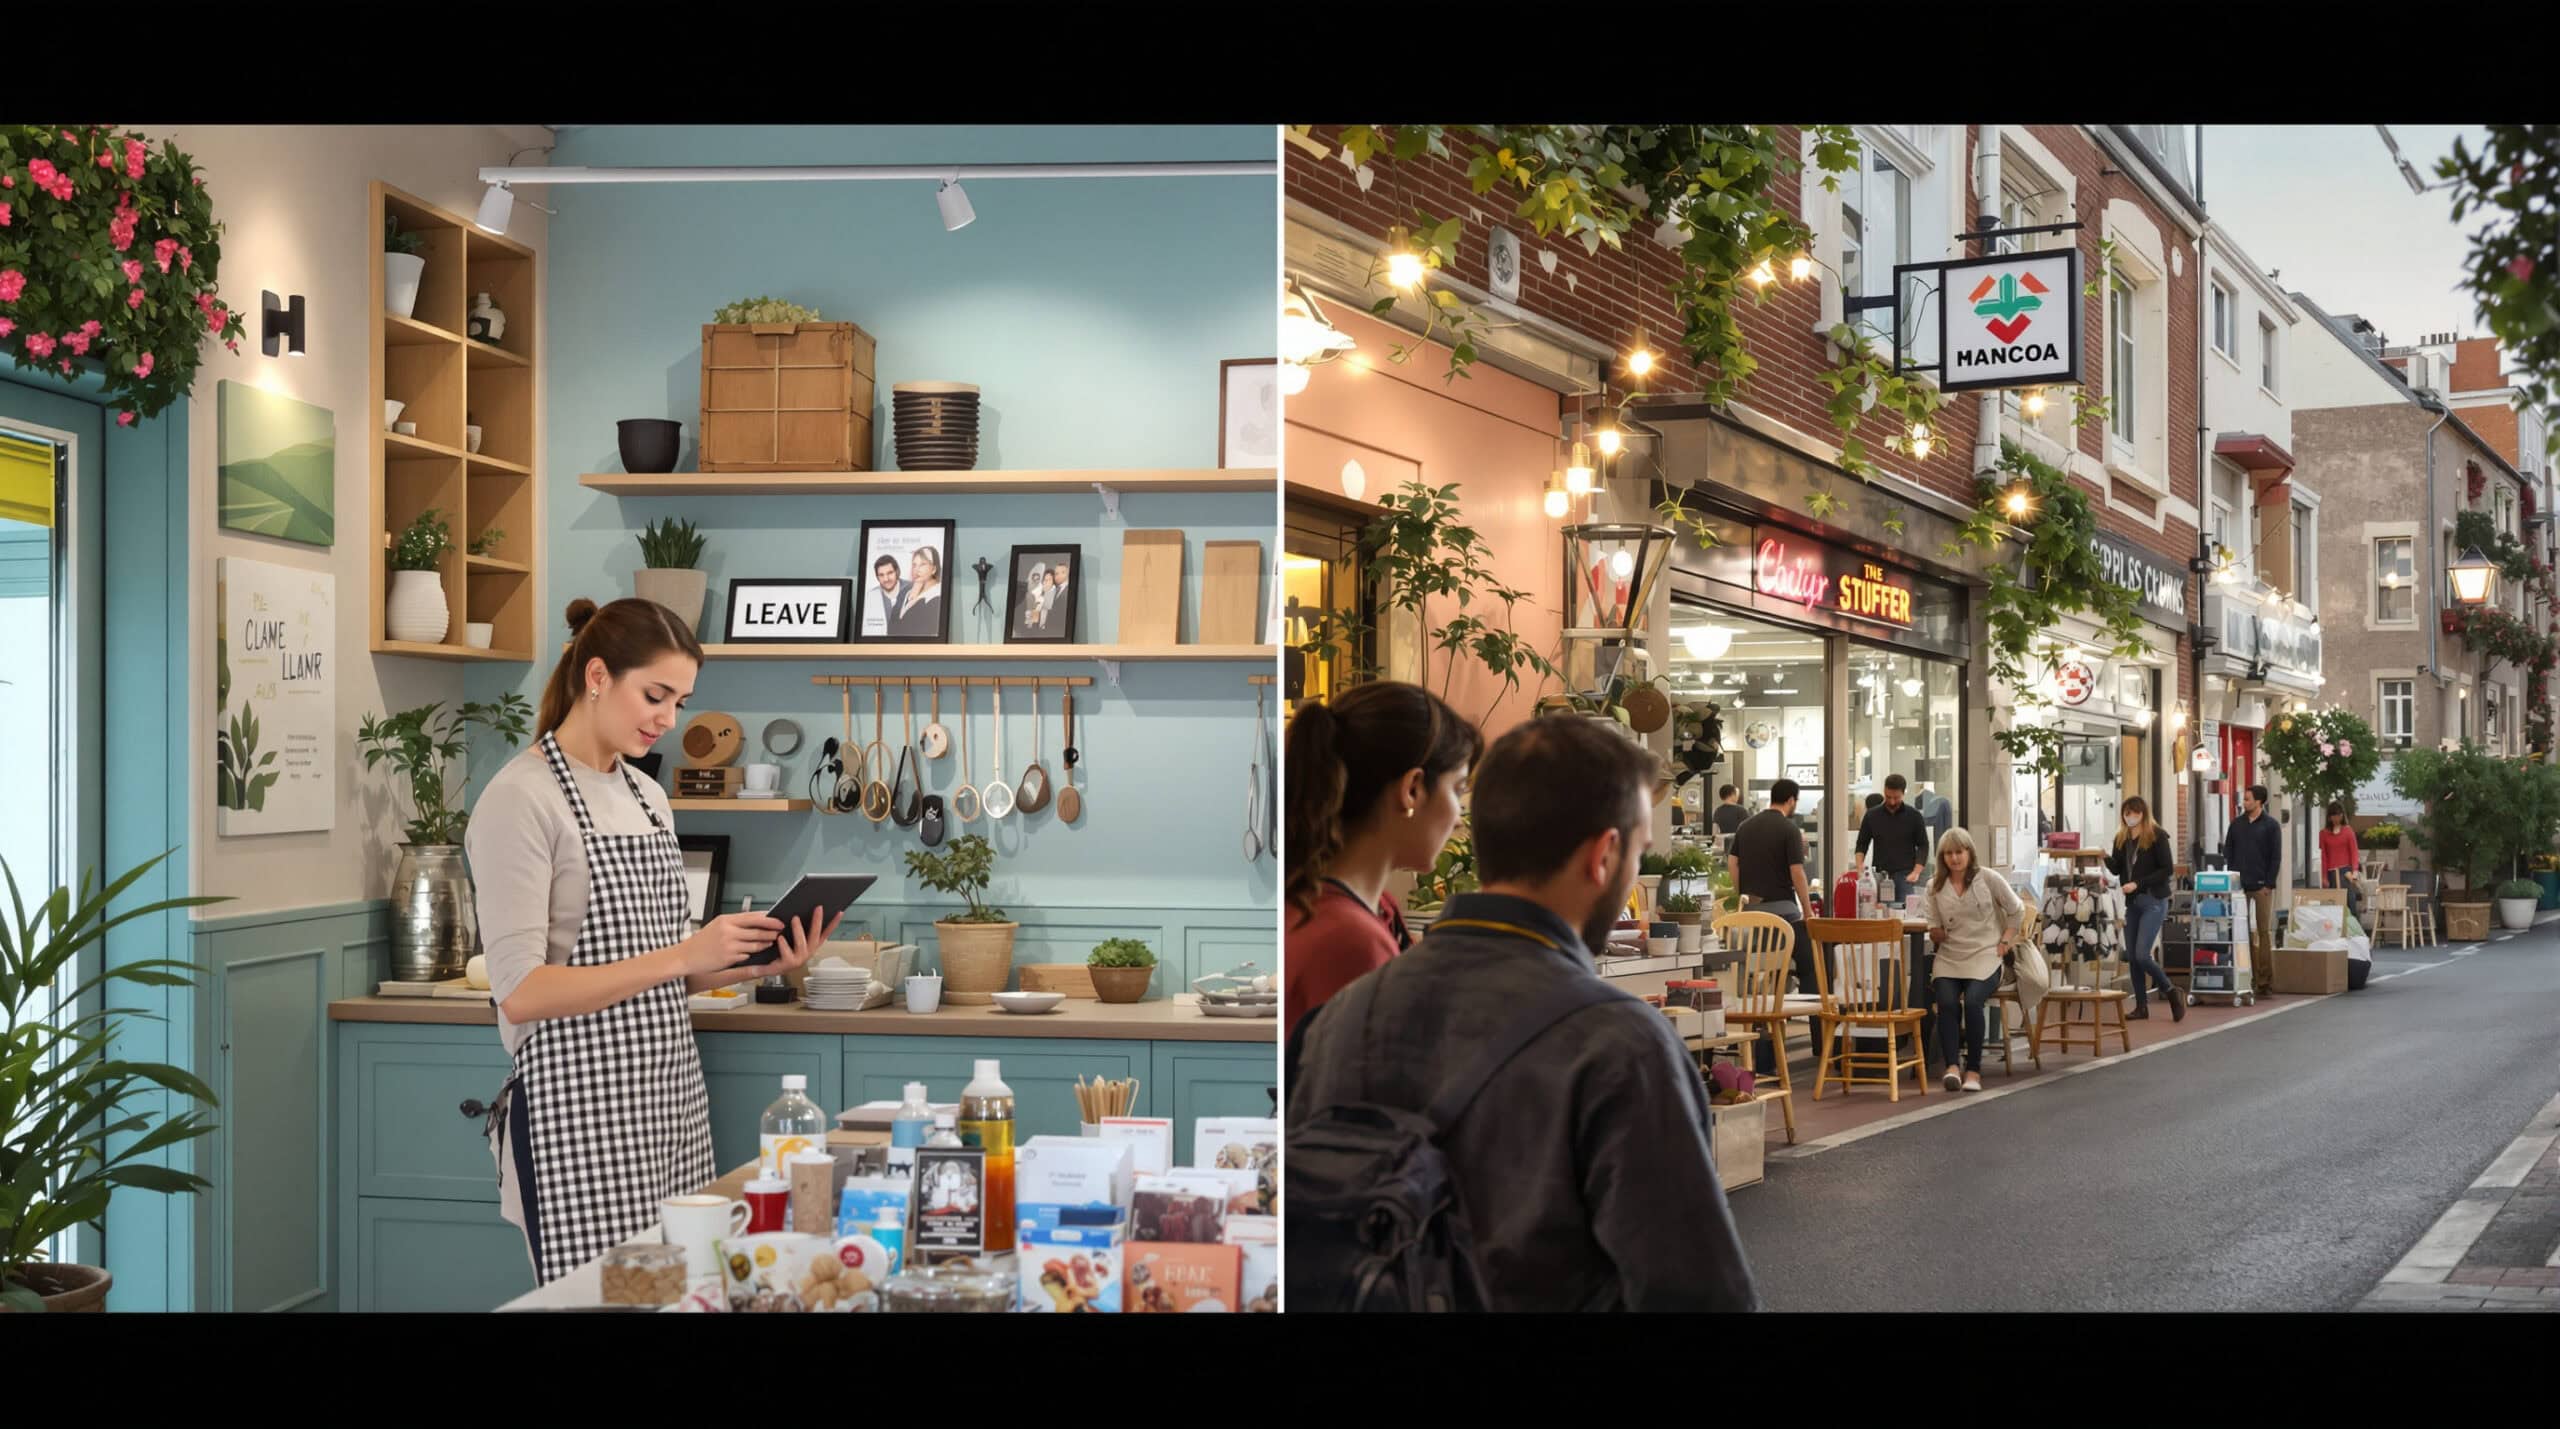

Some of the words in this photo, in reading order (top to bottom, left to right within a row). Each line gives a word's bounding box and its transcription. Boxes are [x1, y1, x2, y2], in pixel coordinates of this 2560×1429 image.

[1957, 343, 2059, 367] MANCOA
[1864, 563, 1884, 582] THE
[1839, 574, 1911, 623] STUFFER
[745, 603, 828, 625] LEAVE
